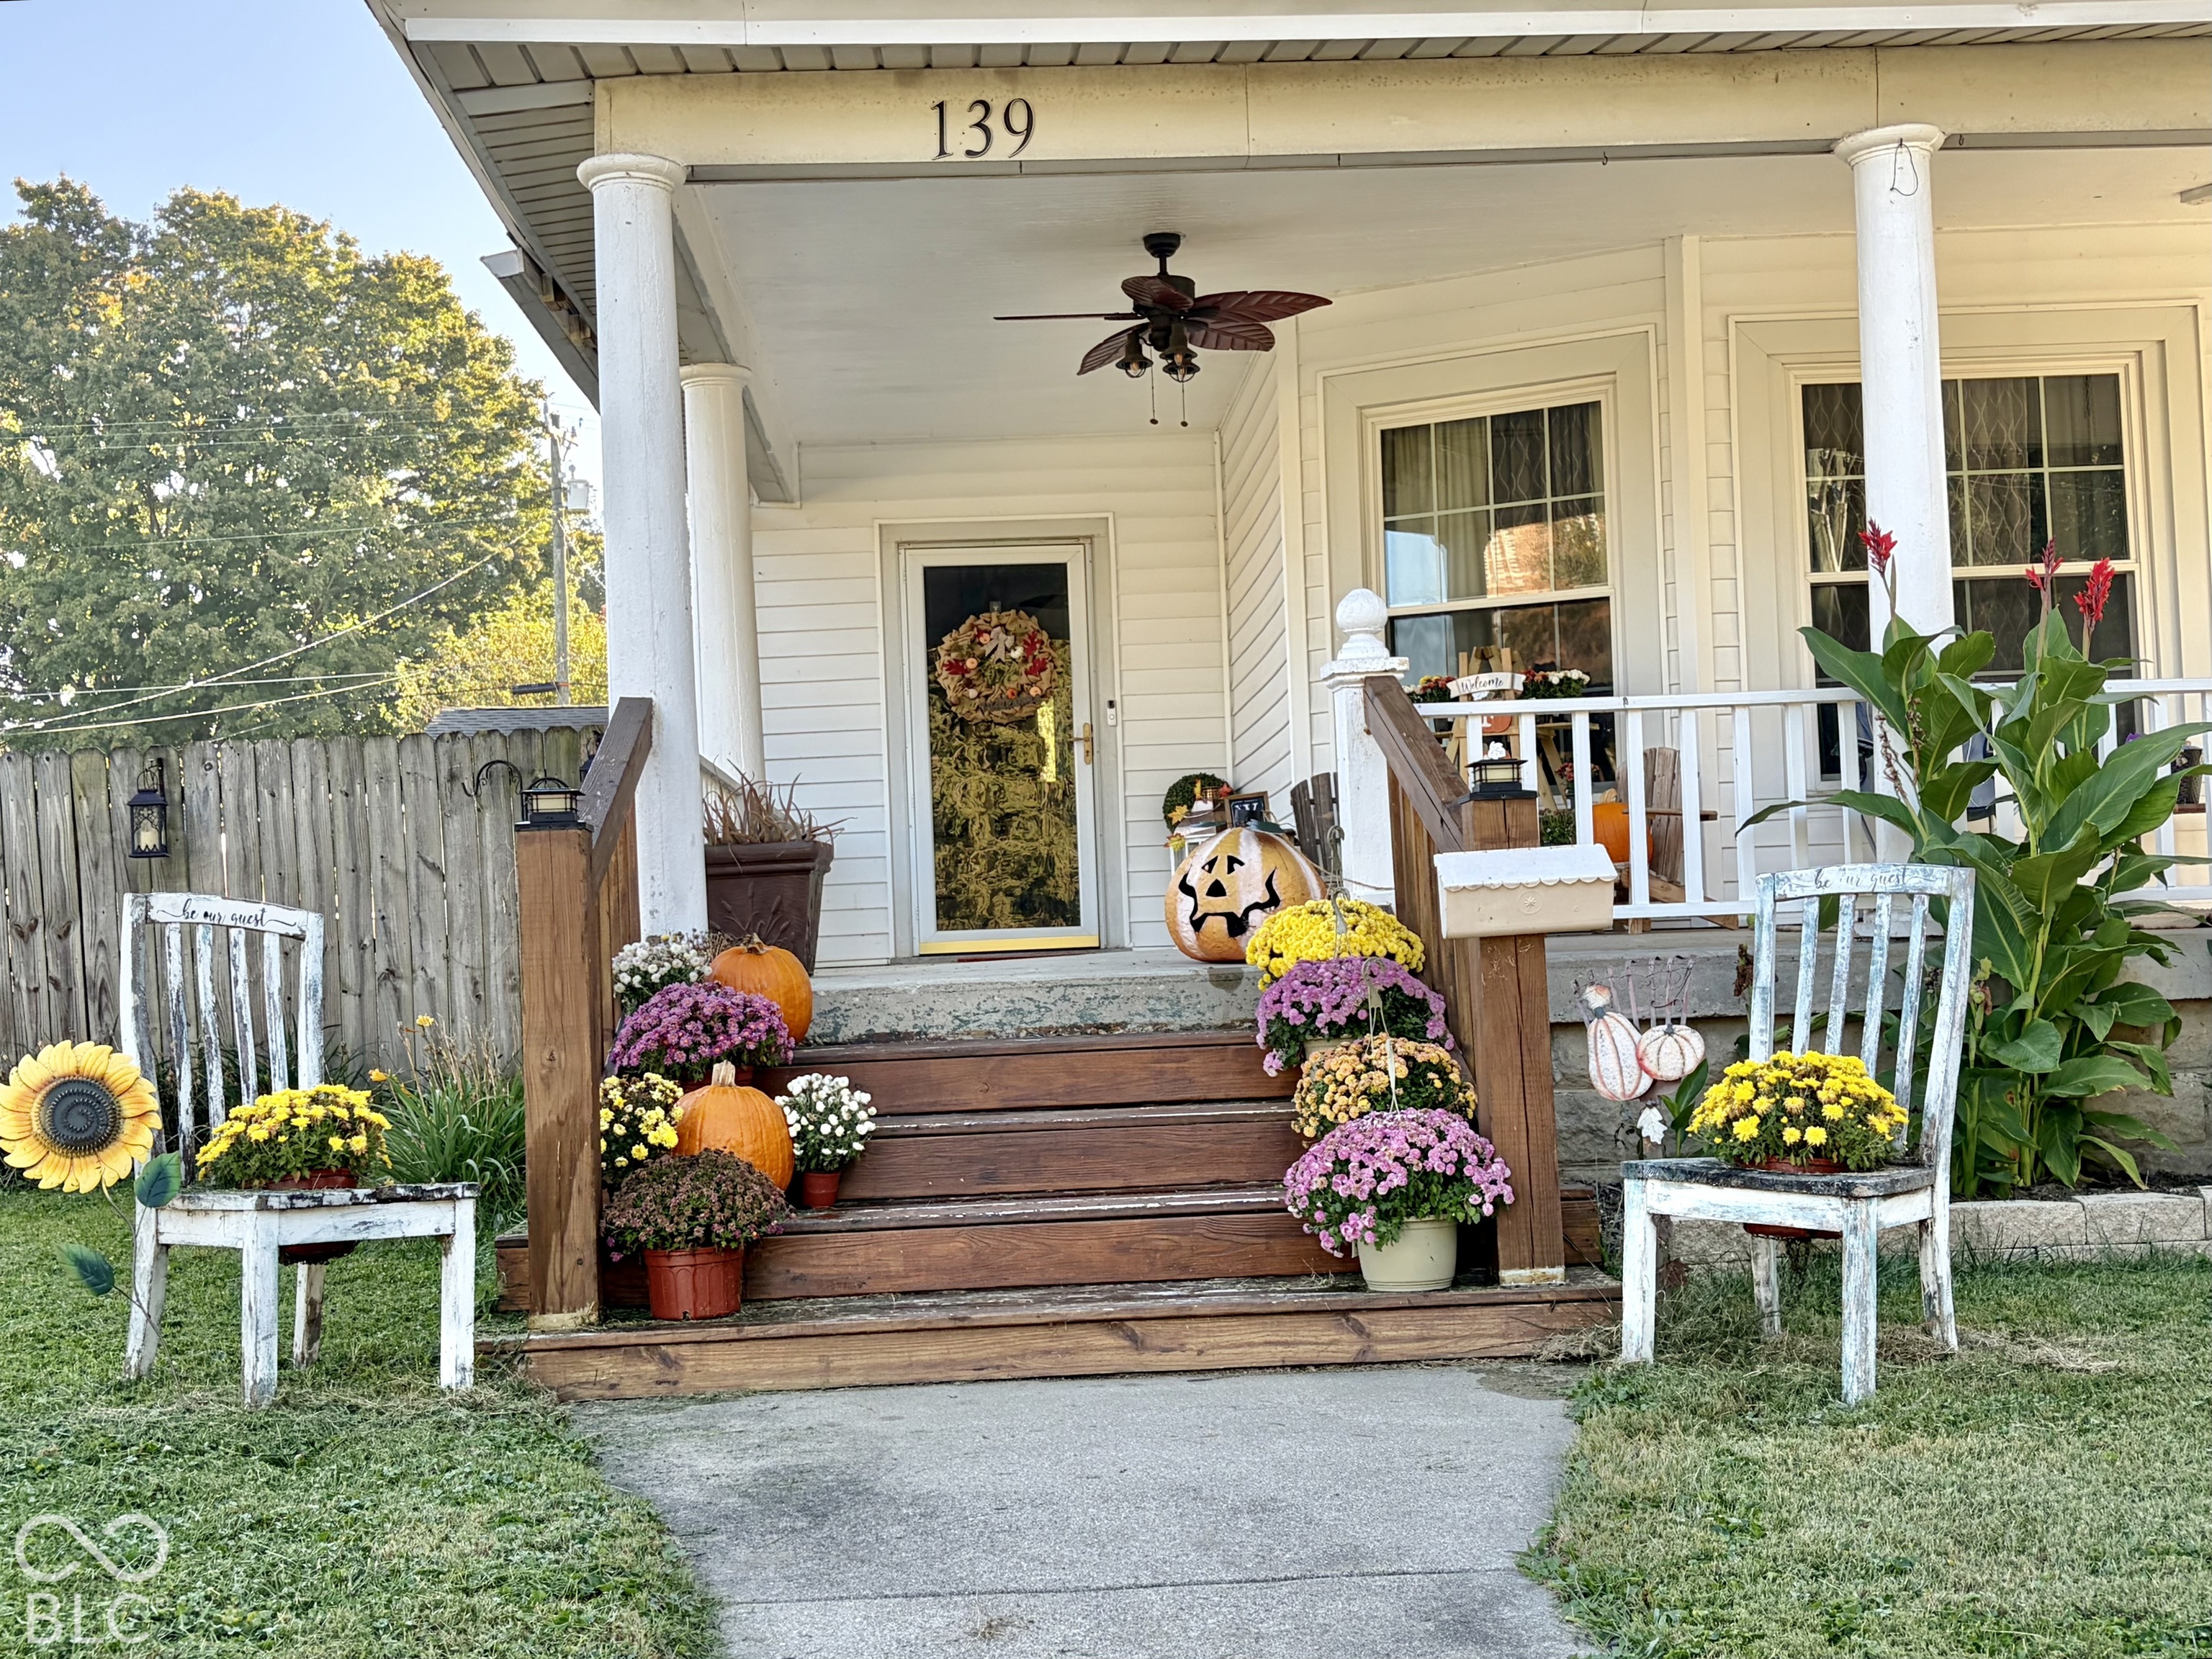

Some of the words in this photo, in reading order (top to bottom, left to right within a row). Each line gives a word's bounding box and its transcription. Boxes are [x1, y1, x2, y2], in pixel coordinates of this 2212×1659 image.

[931, 98, 1035, 161] 139
[1460, 675, 1505, 692] Welcome
[1815, 868, 1832, 889] be
[1840, 873, 1863, 887] ur
[1869, 866, 1907, 892] guest
[182, 898, 199, 920] be
[203, 911, 226, 925] our
